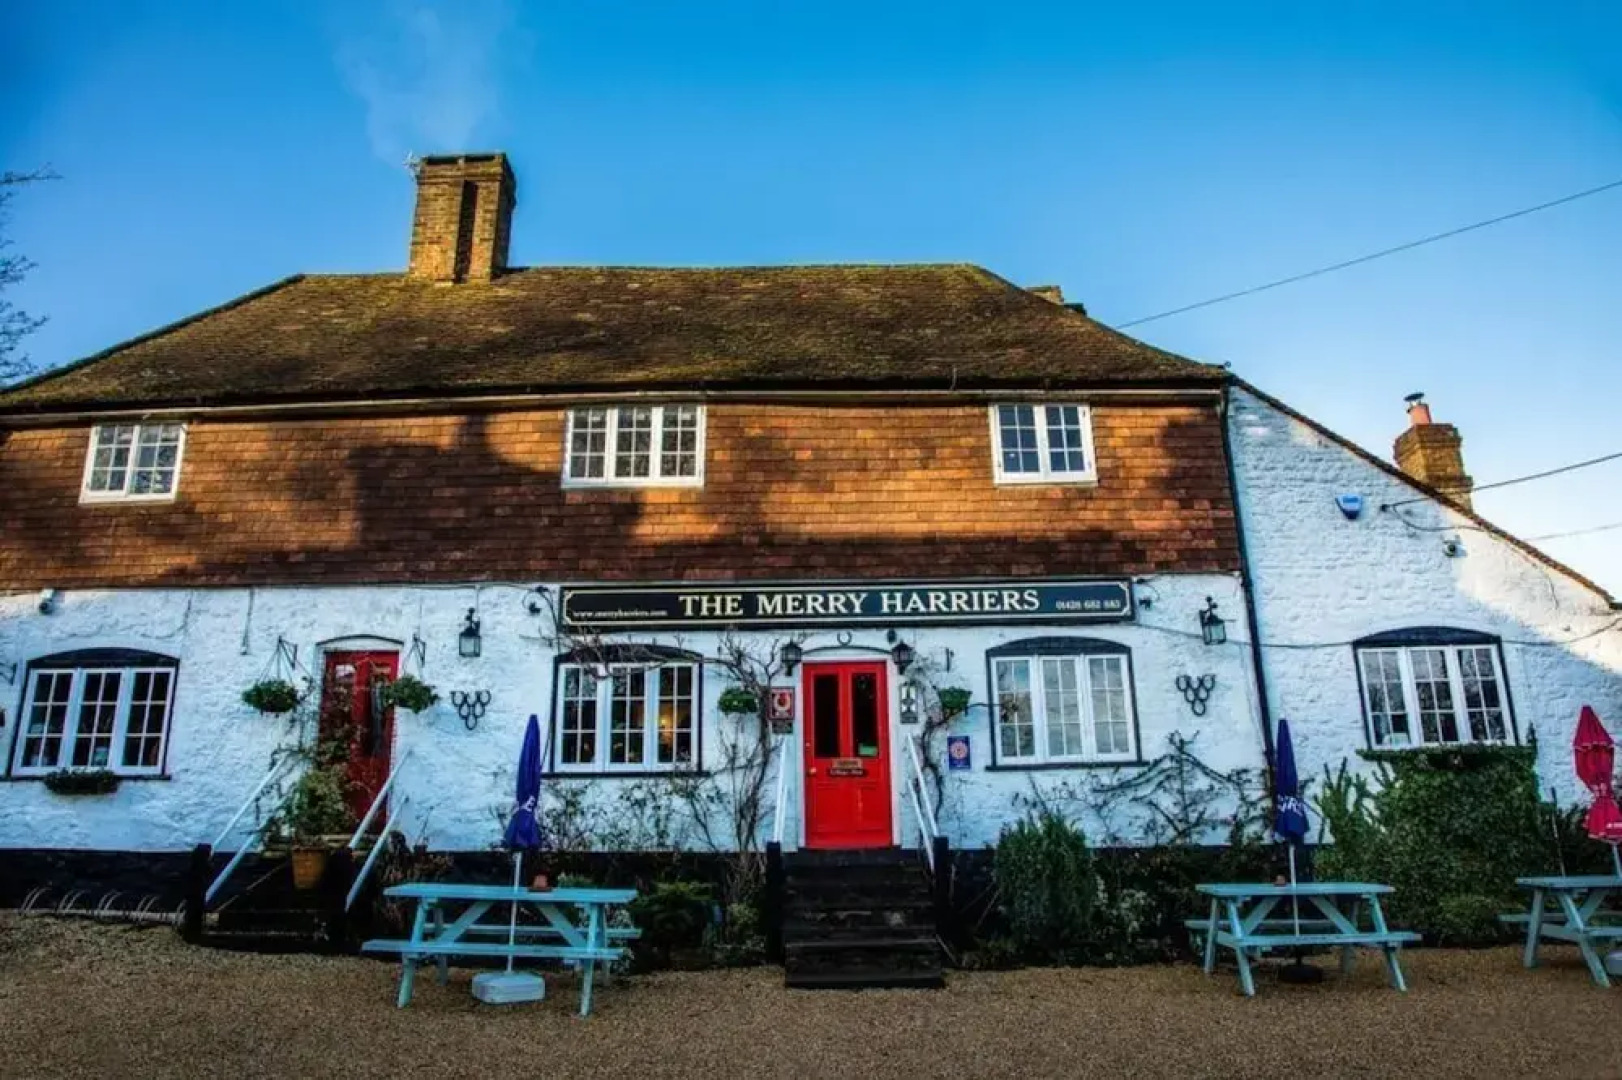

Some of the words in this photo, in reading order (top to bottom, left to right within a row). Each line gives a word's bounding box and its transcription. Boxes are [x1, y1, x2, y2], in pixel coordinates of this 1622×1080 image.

[679, 595, 743, 616] THE
[757, 592, 865, 615] MERRY
[881, 590, 1039, 612] HARRIERS
